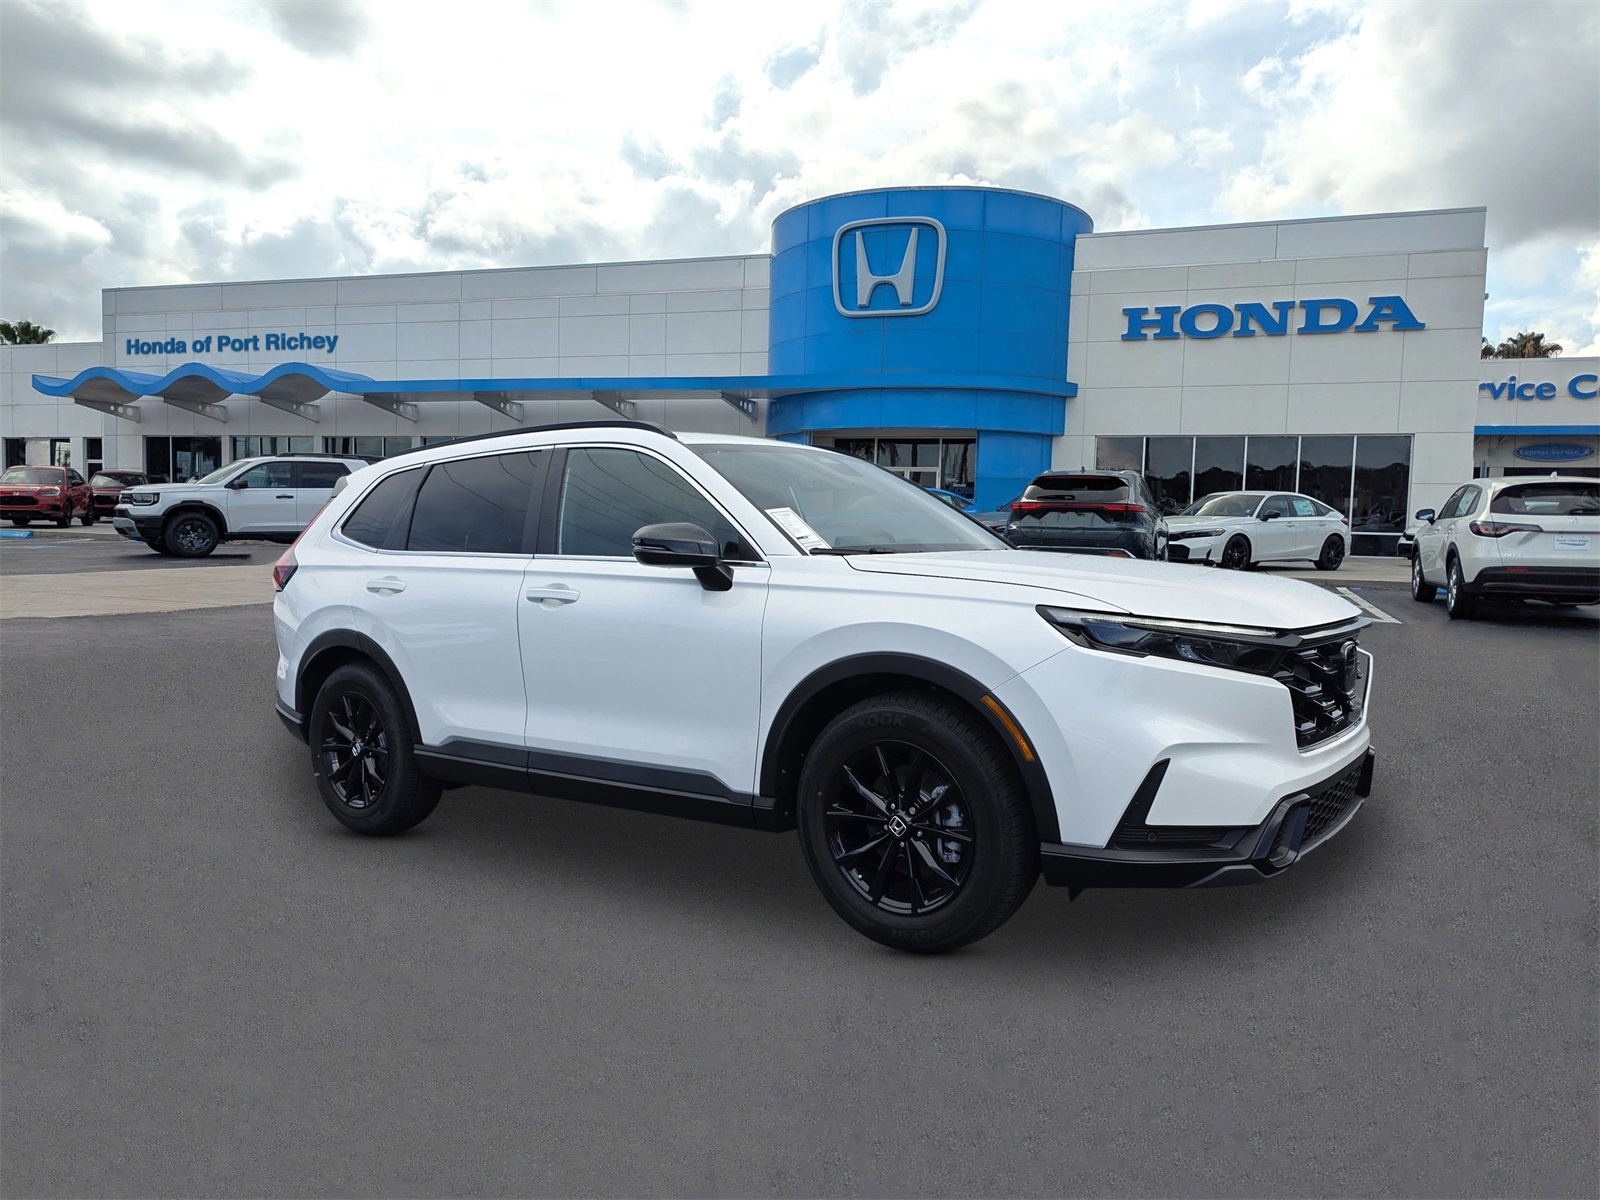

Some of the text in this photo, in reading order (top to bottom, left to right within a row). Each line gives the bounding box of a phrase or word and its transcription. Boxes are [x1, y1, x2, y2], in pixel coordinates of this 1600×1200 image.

[1121, 295, 1426, 341] HONDA
[126, 332, 339, 355] Honda of Port Richey
[1567, 373, 1600, 400] C
